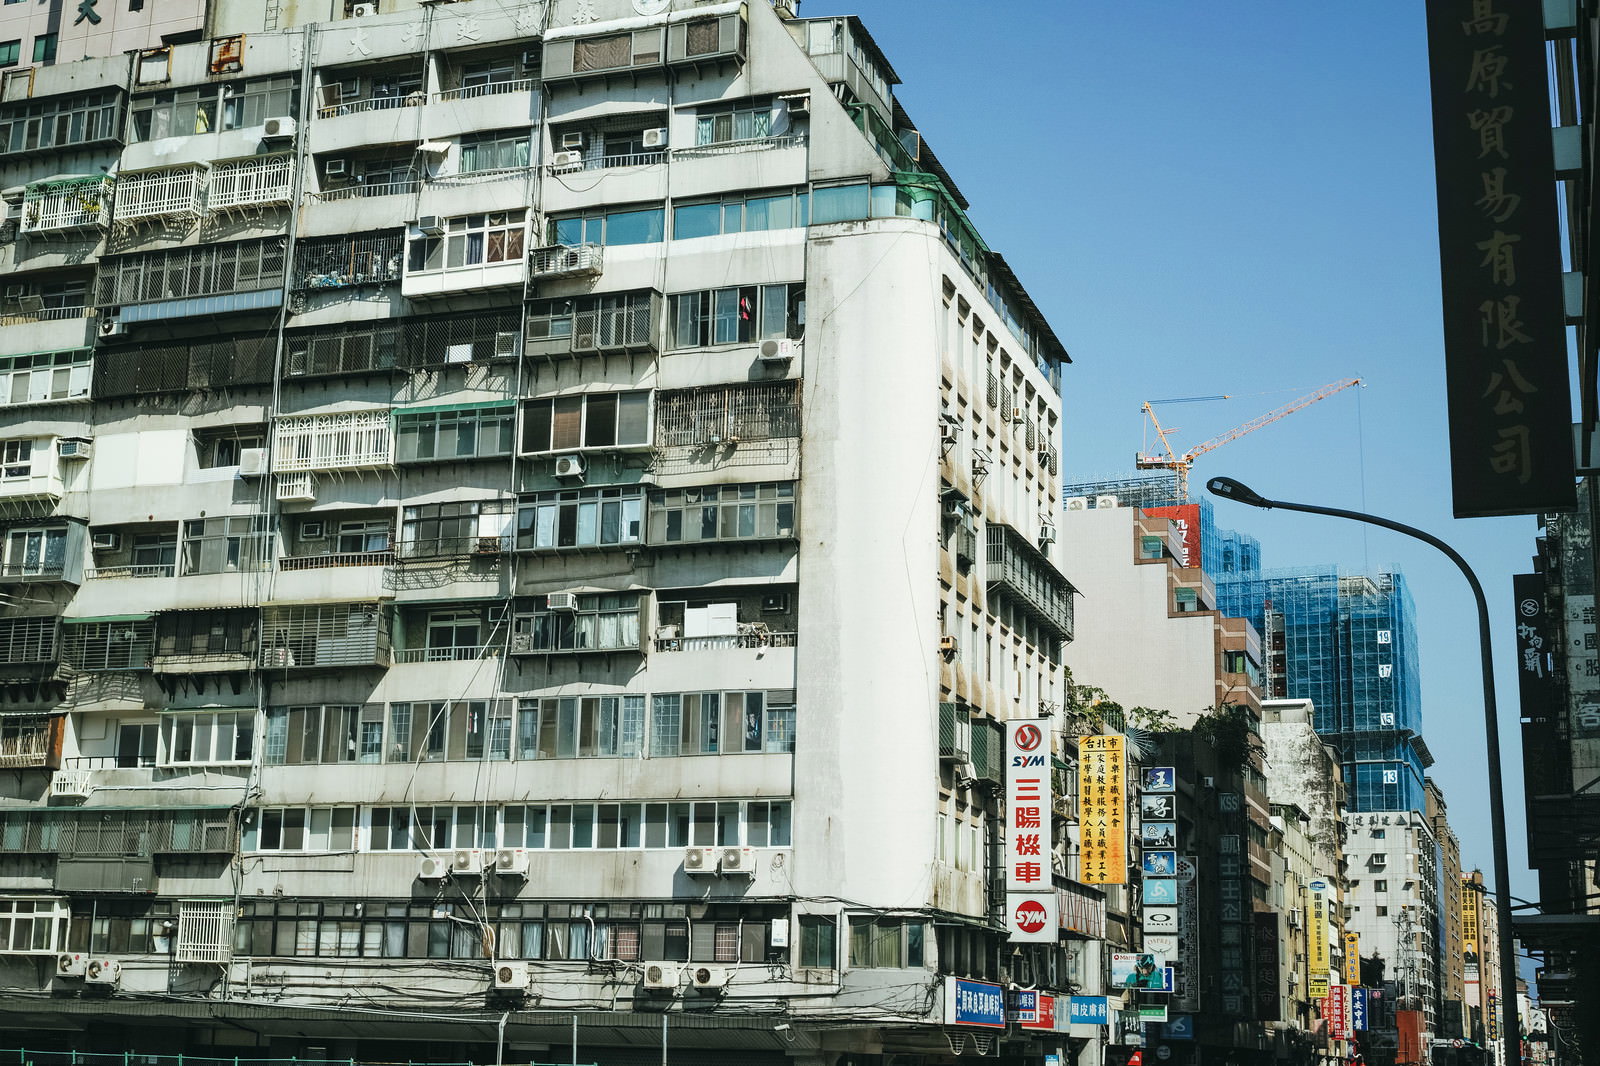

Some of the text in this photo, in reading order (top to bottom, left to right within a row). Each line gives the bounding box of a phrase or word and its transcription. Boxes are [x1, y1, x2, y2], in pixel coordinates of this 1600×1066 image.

[1379, 631, 1389, 642] 19
[1380, 665, 1390, 677] 17
[1381, 714, 1392, 725] 15
[1085, 738, 1118, 749] 台北市
[1012, 755, 1045, 767] SYM
[1384, 771, 1396, 783] 13
[1220, 796, 1238, 810] KSS
[1015, 778, 1041, 883] 三陽機車
[1016, 910, 1047, 927] SYM
[1071, 1002, 1106, 1017] 周皮膚科
